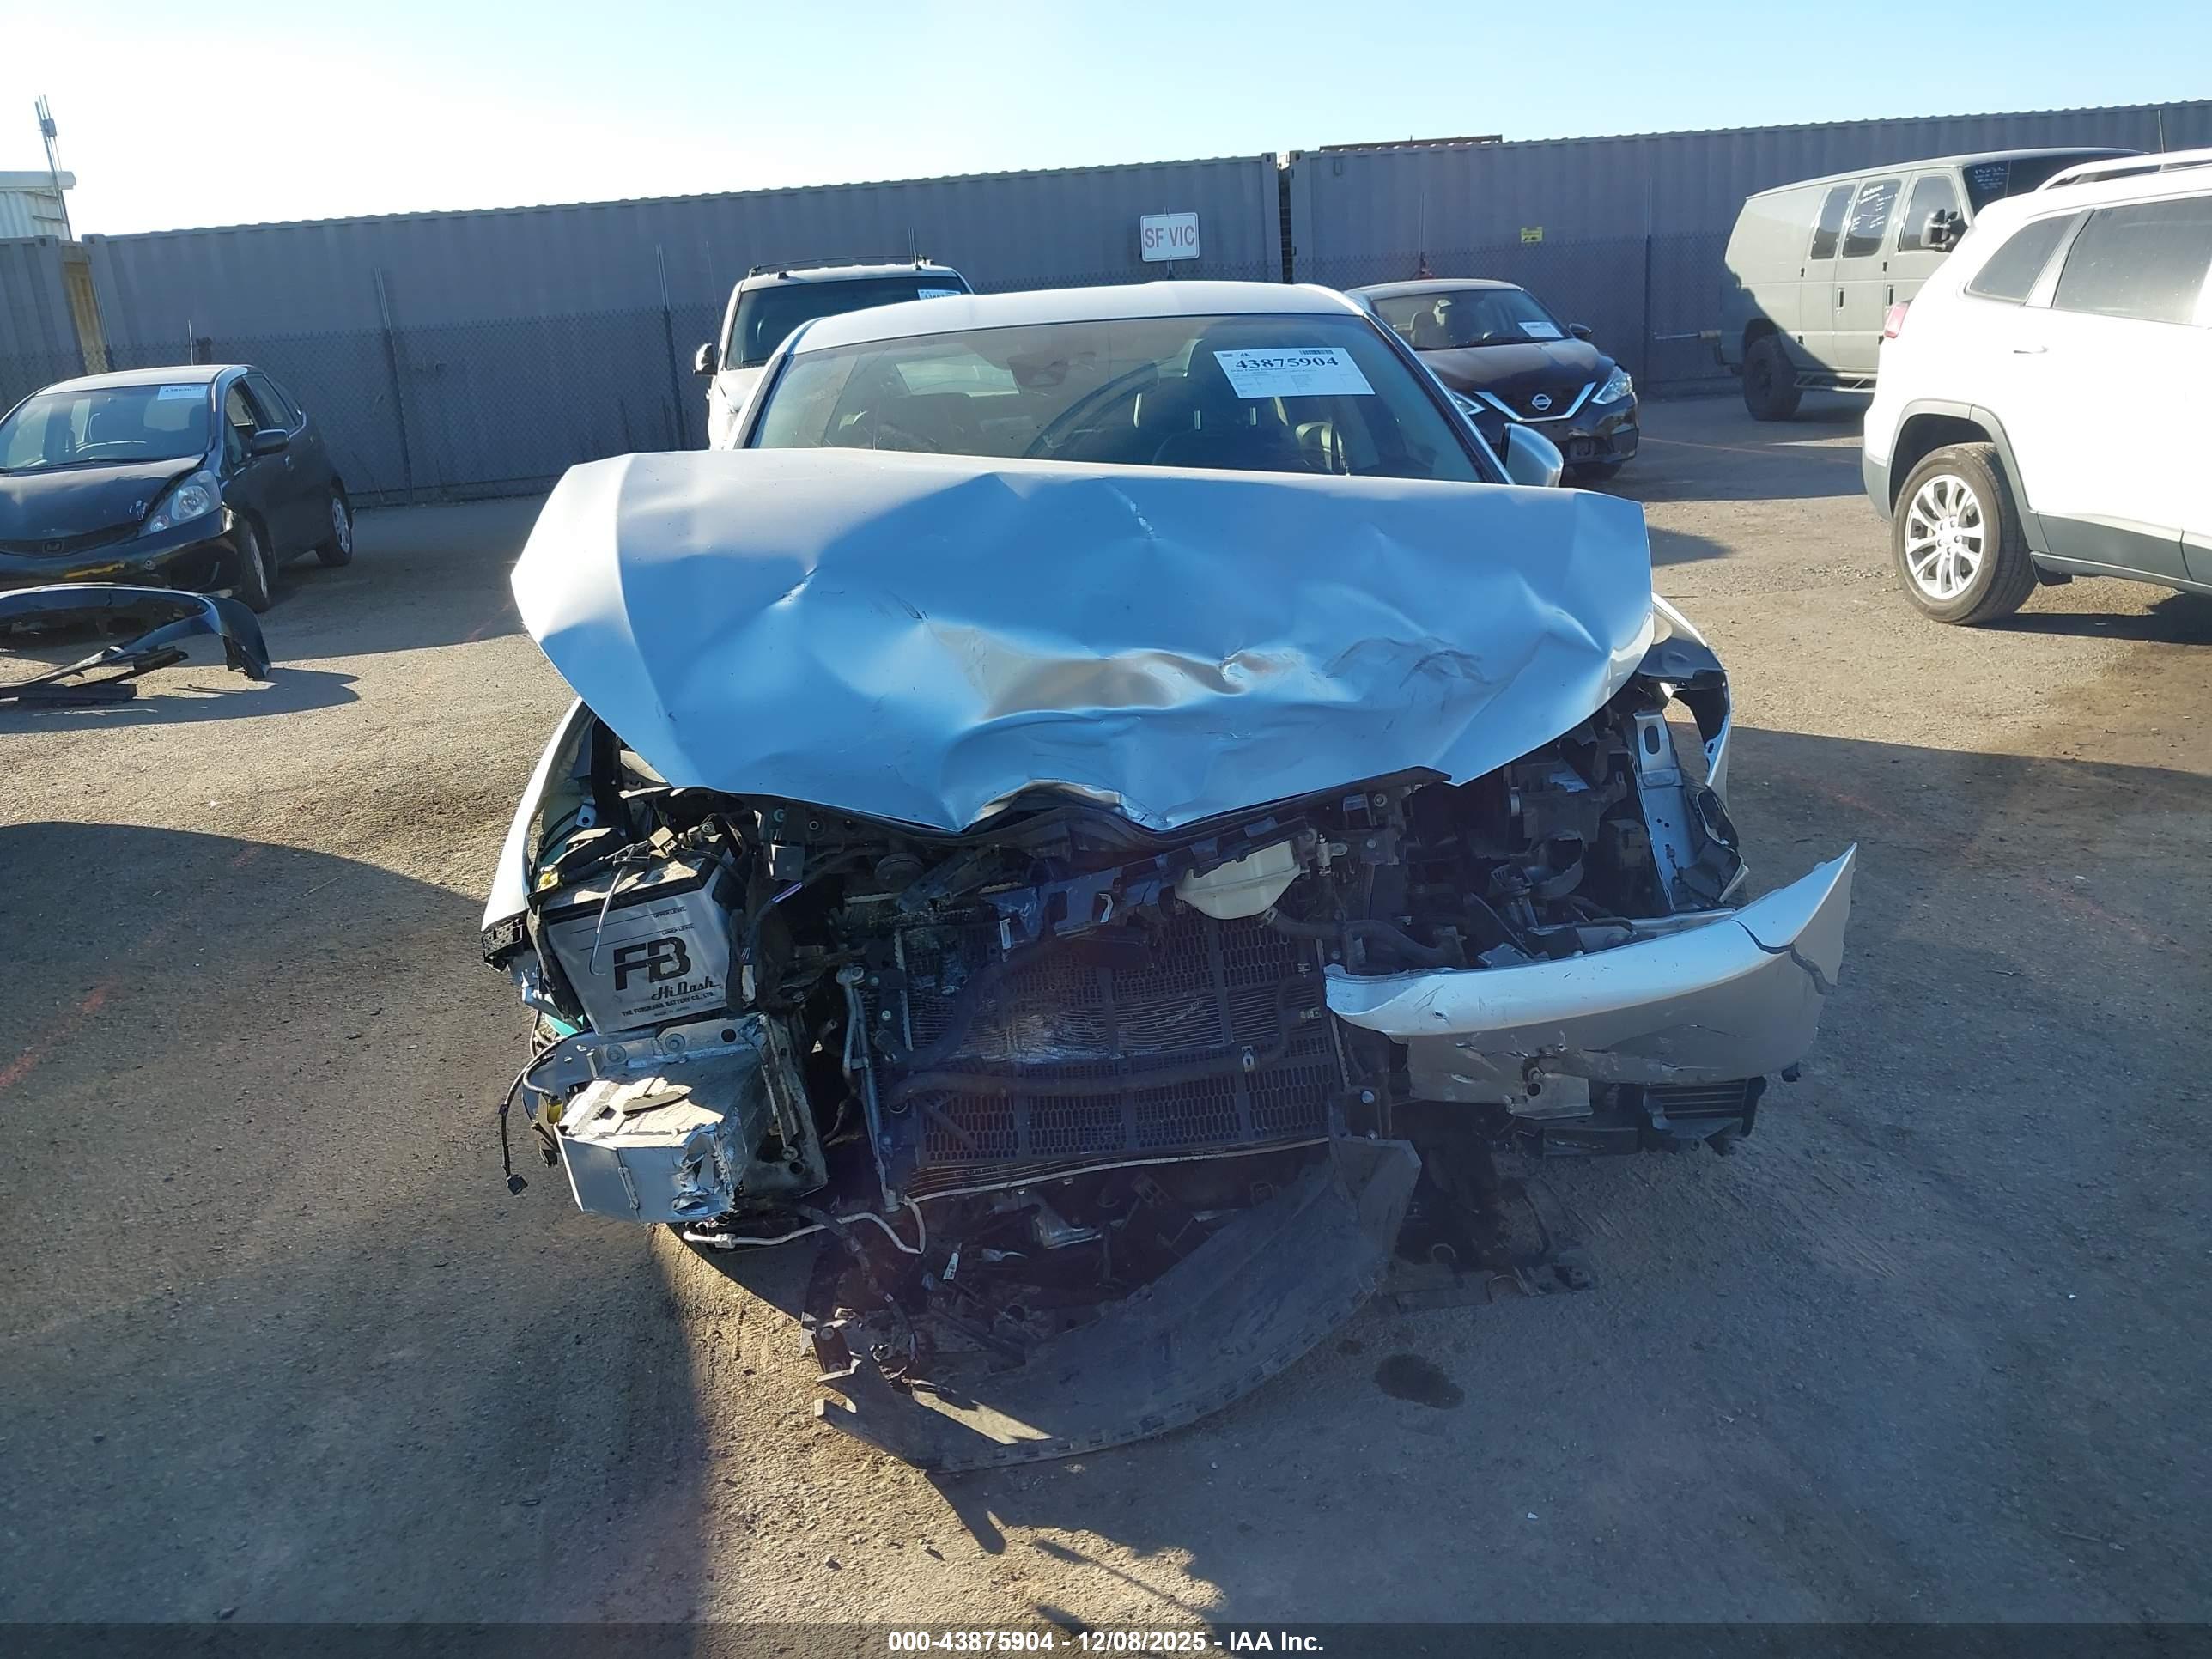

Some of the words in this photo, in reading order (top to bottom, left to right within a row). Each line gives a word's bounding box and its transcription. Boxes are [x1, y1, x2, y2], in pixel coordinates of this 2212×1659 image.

[1145, 228, 1164, 248] SF
[1168, 225, 1195, 246] VIC
[1236, 356, 1339, 369] 43875904
[614, 937, 691, 991] FB
[665, 997, 690, 1006] BATTERY
